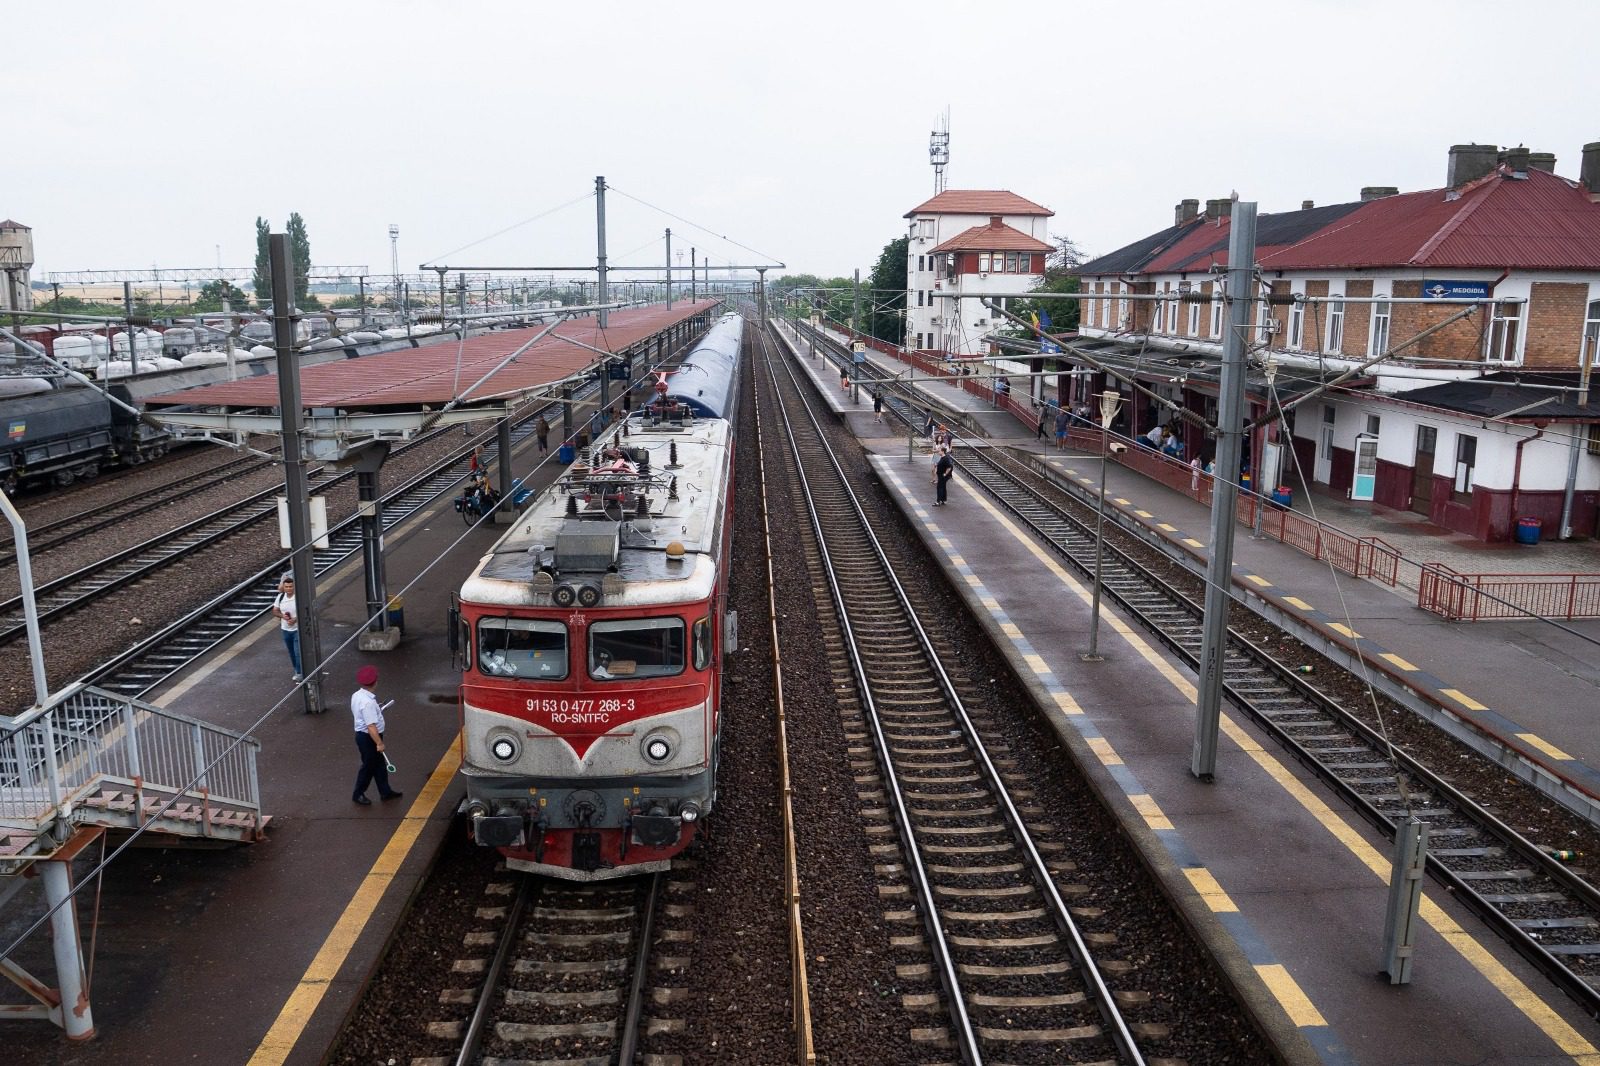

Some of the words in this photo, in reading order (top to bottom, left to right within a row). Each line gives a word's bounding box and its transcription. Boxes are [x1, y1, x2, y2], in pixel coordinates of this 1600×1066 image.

[526, 699, 539, 711] 91
[542, 699, 558, 712] 53
[560, 700, 569, 712] 0
[571, 700, 594, 713] 477
[598, 698, 636, 712] 268-3
[551, 713, 609, 724] RO-SNTFC
